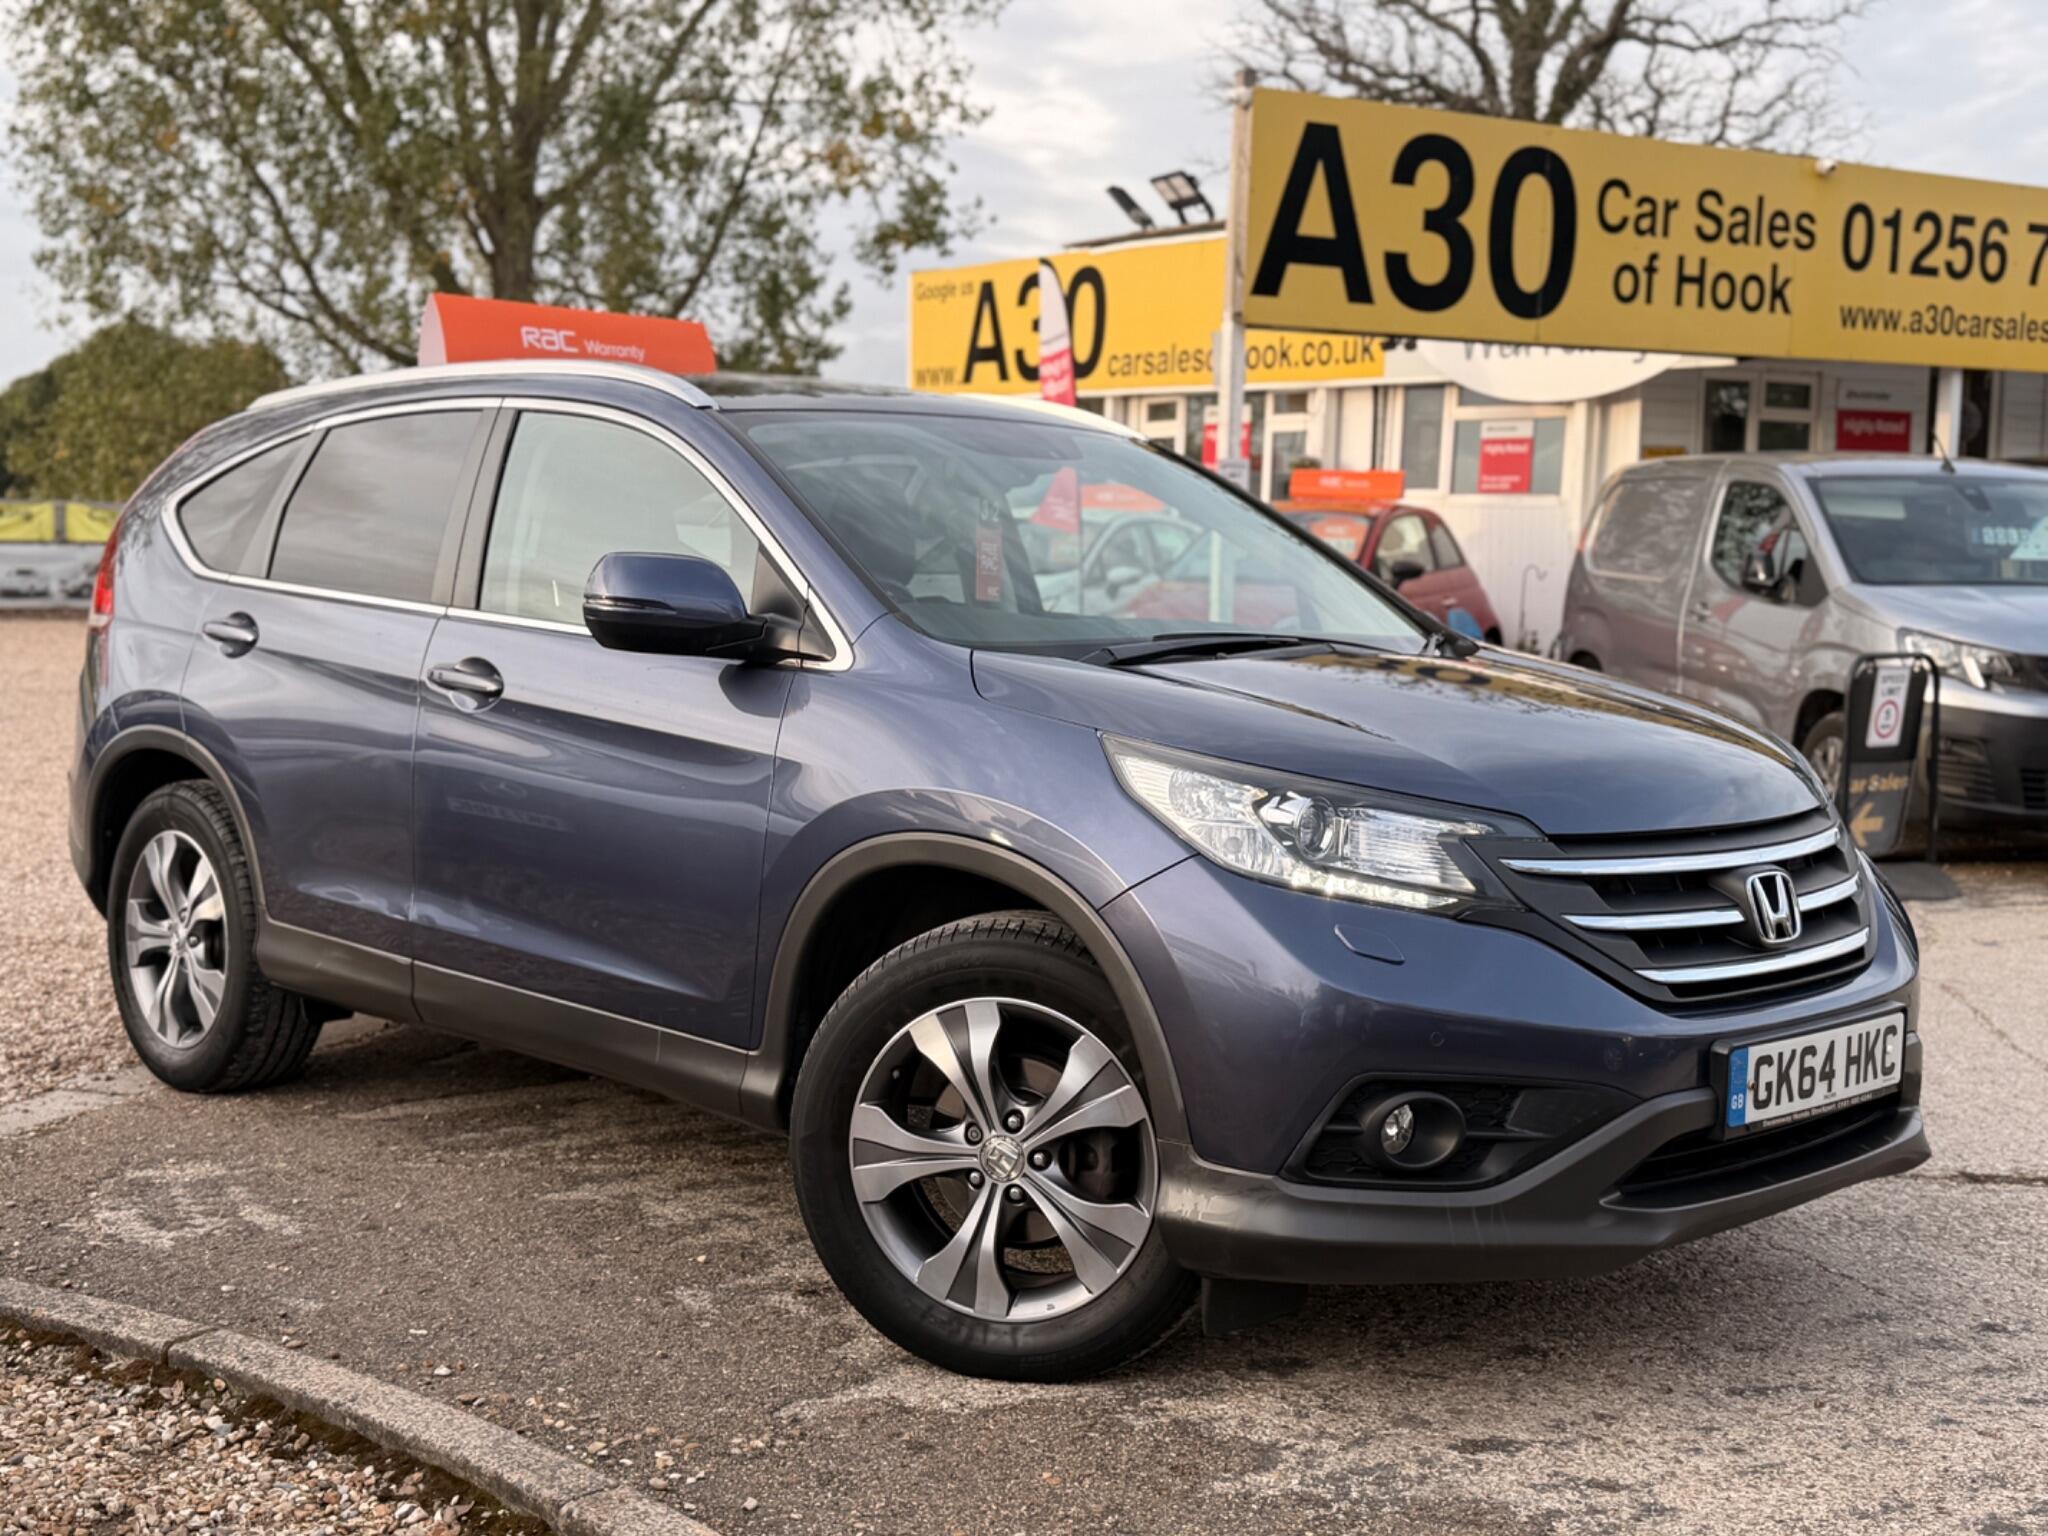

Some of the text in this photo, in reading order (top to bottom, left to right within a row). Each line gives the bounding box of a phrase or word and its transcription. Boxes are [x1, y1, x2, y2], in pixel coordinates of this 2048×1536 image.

[1252, 121, 1577, 320] A30
[1597, 178, 1817, 252] Car Sales
[1843, 202, 2010, 284] 01256
[963, 266, 1106, 384] A30
[1613, 255, 1792, 316] of Hook
[584, 339, 646, 362] Warranty
[1730, 1024, 1898, 1111] GB GK64 HKC
